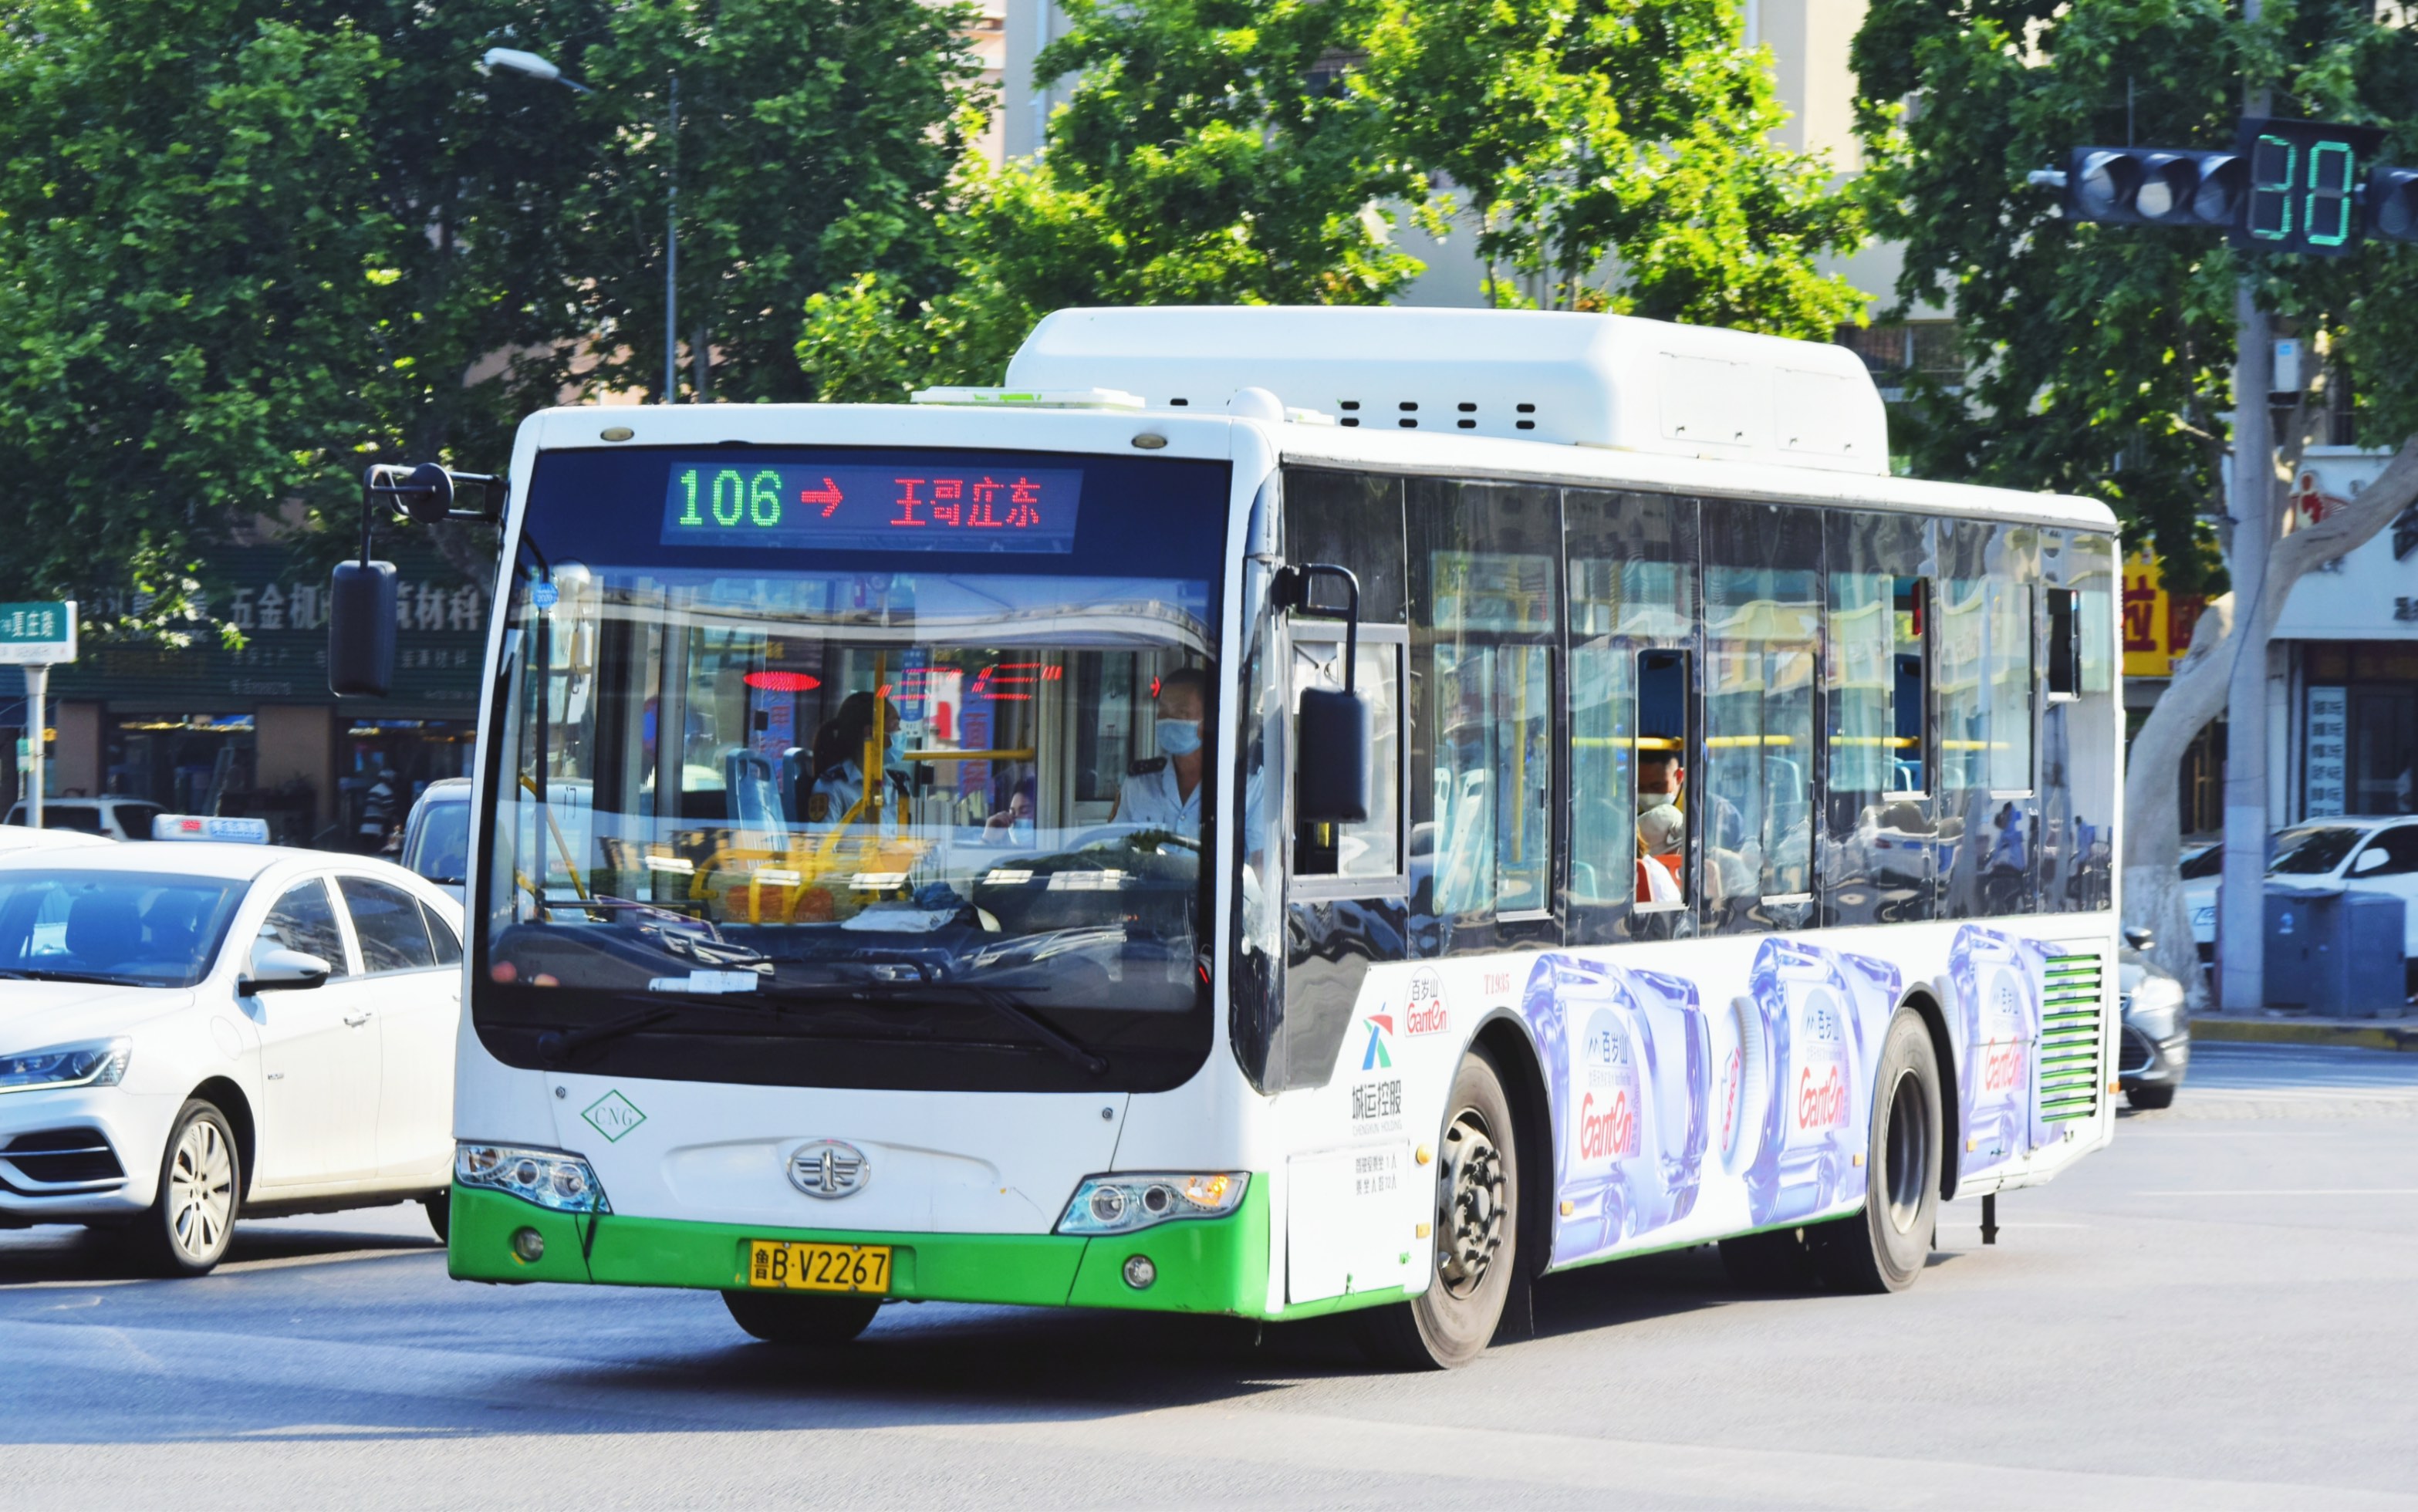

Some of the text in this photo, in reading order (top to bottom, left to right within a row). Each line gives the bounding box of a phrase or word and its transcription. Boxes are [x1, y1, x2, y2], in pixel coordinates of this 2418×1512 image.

[2248, 134, 2354, 246] 30
[680, 469, 782, 527] 106
[1413, 977, 1438, 1001] 百岁山
[1484, 973, 1510, 994] T1935
[1602, 1031, 1628, 1064] 百岁山
[594, 1106, 634, 1127] CNG
[1352, 1080, 1401, 1120] 城运控股
